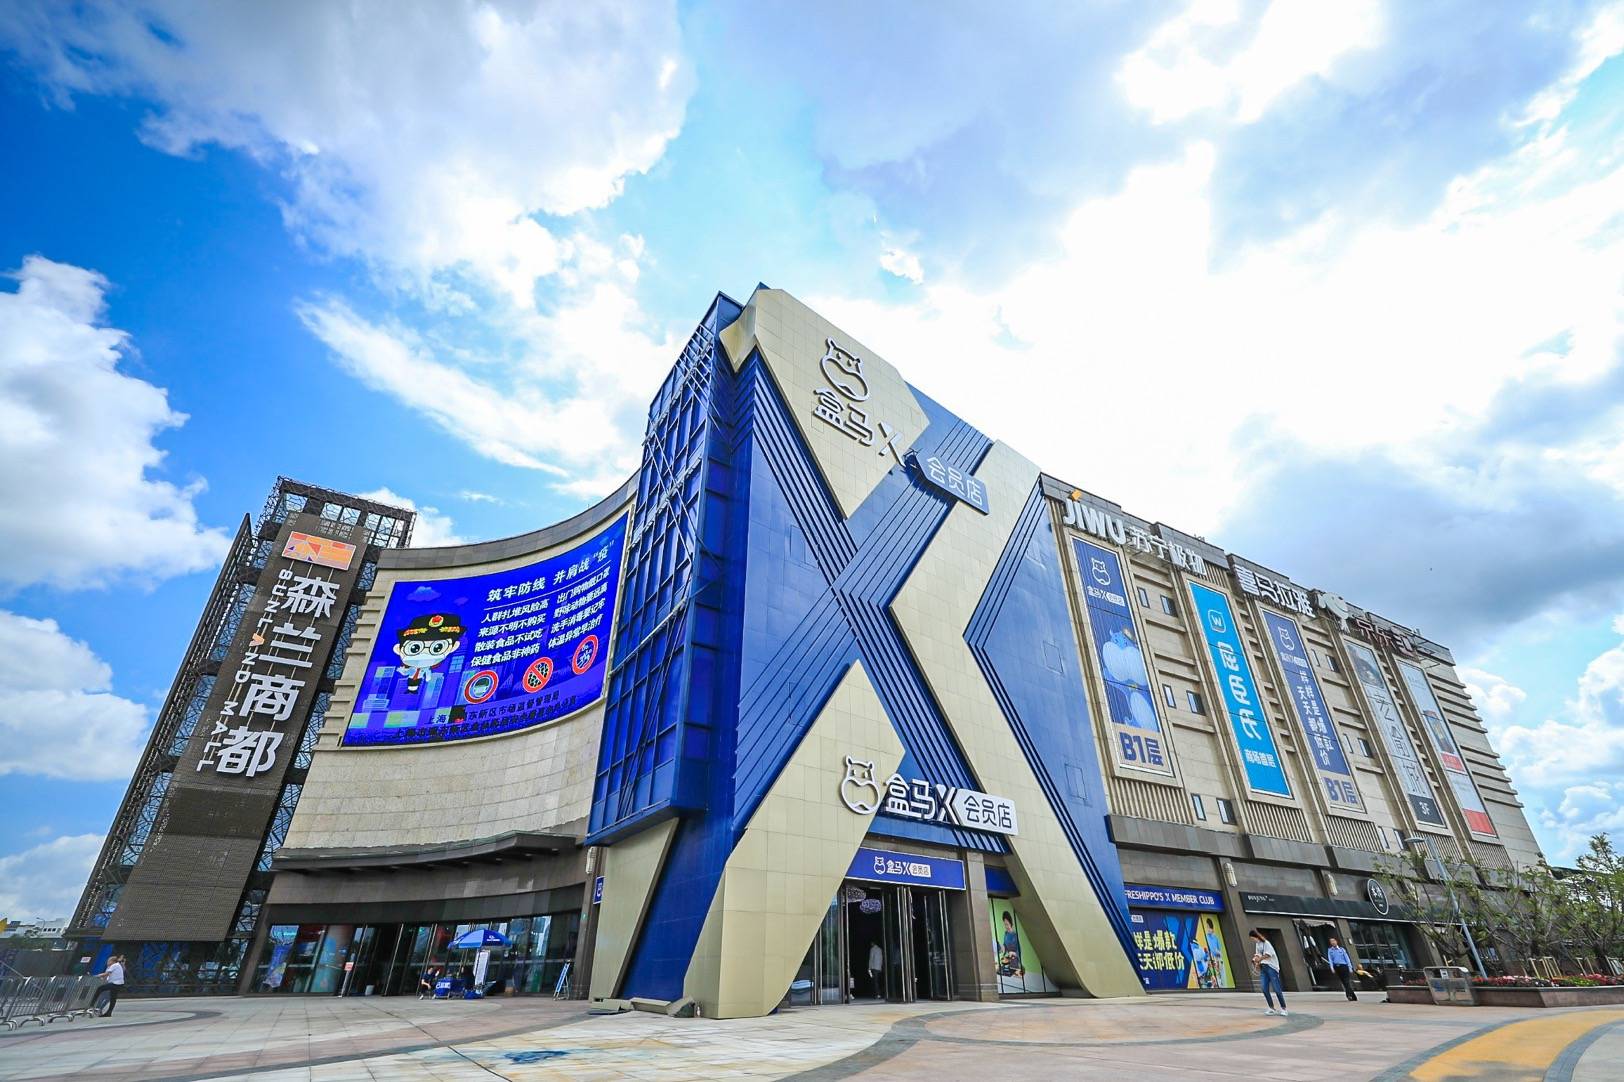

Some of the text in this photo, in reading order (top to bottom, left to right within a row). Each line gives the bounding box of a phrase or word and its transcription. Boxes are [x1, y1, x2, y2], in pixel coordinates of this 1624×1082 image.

[813, 386, 984, 506] 盒马X 会员店
[1063, 489, 1207, 577] JIWU 苏宁极物
[481, 598, 550, 624] 人群扎堆风险高
[486, 577, 547, 603] 筑牢防线
[1234, 564, 1316, 618] 喜马拉雅
[470, 613, 604, 668] 保健食品非神药 体温异常早治疗
[474, 598, 606, 653] 散装食品不试吃 洗手消毒要记牢
[478, 613, 547, 638] 来源不明不购买
[216, 574, 339, 778] 森兰商都
[1217, 641, 1262, 741] 屈臣氏
[196, 701, 239, 772] MALL
[1120, 731, 1164, 766] B1层
[884, 772, 1012, 830] 盒马X 会员店
[1323, 777, 1358, 805] B1层
[886, 859, 930, 876] 盒马X 会员店
[1171, 893, 1198, 904] MEMBER
[1199, 895, 1215, 905] CLUB
